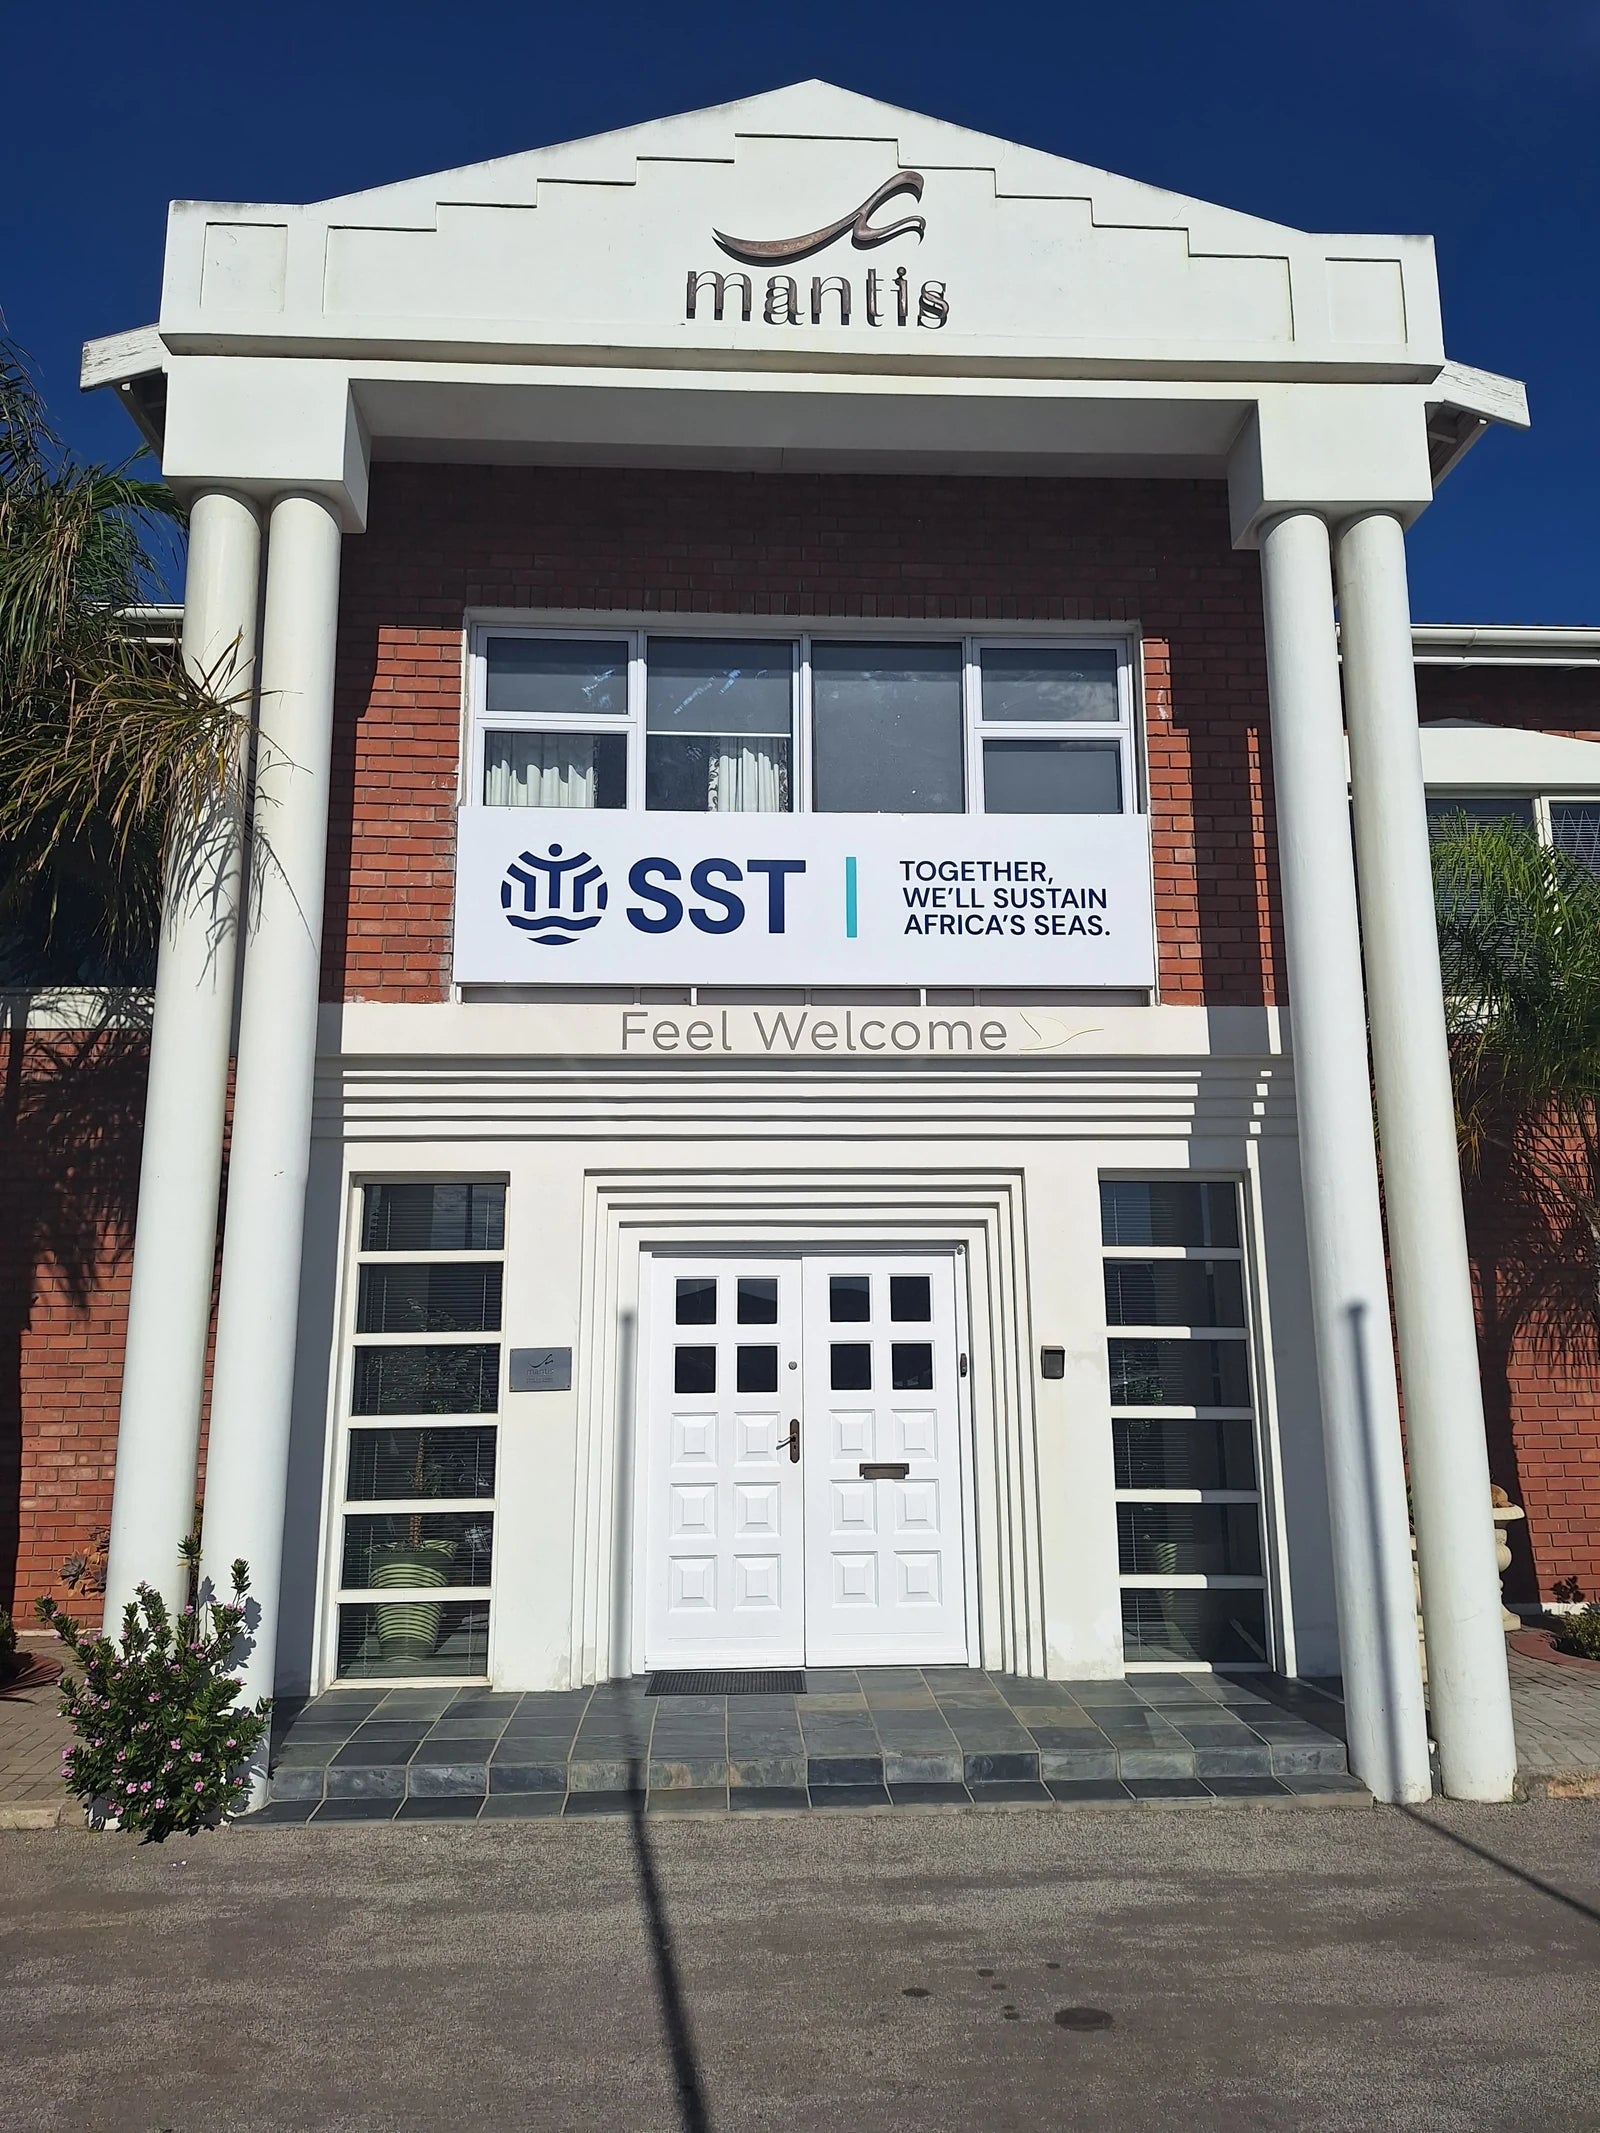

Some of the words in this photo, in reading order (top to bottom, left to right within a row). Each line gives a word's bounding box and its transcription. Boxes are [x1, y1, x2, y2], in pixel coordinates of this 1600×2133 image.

[685, 265, 950, 329] mantis
[899, 860, 1054, 885] TOGETHER,
[626, 856, 806, 935] SST
[902, 887, 985, 909] WE’LL
[993, 887, 1108, 910] SUSTAIN
[903, 913, 1026, 936] AFRICA’S
[1034, 914, 1111, 936] SEAS.
[621, 1010, 732, 1051] Feel
[752, 1010, 1008, 1051] Welcome
